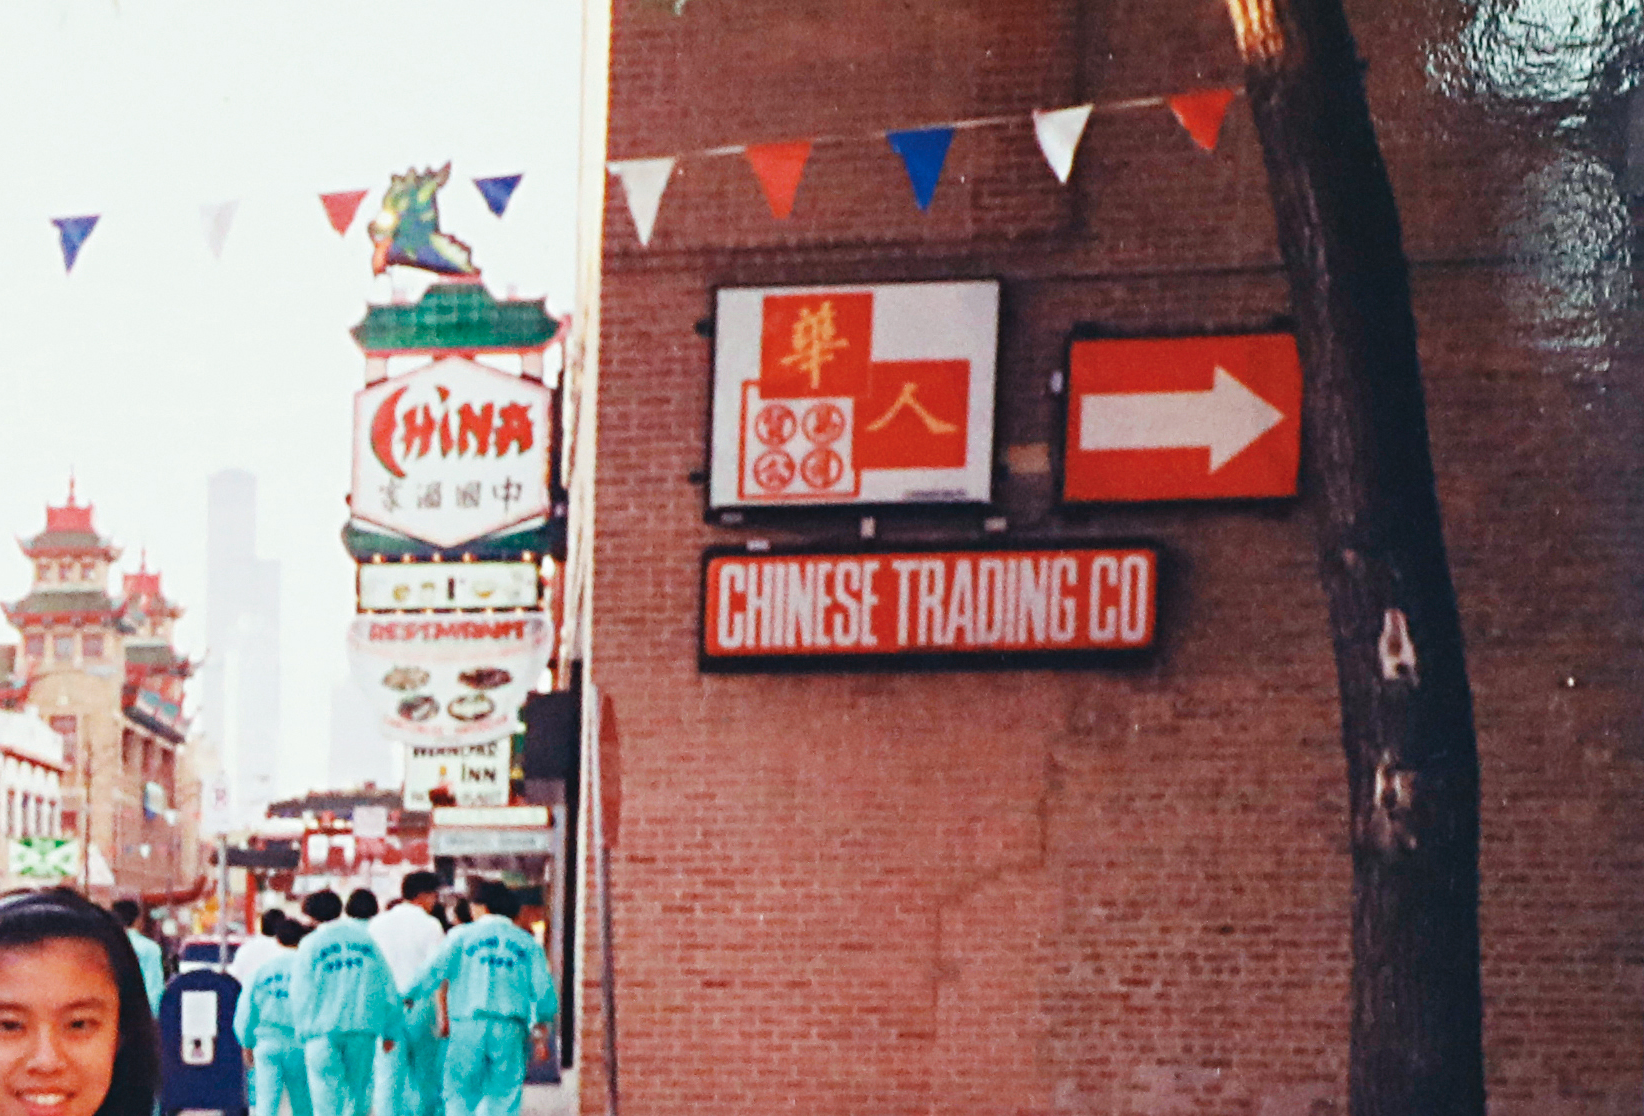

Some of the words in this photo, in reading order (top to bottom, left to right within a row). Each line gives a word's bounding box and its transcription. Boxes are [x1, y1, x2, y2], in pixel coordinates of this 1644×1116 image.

[779, 299, 851, 390] 華
[863, 381, 959, 434] 人
[717, 560, 880, 649] CHINESE
[891, 556, 1078, 647] TRADING
[1088, 553, 1149, 644] CO
